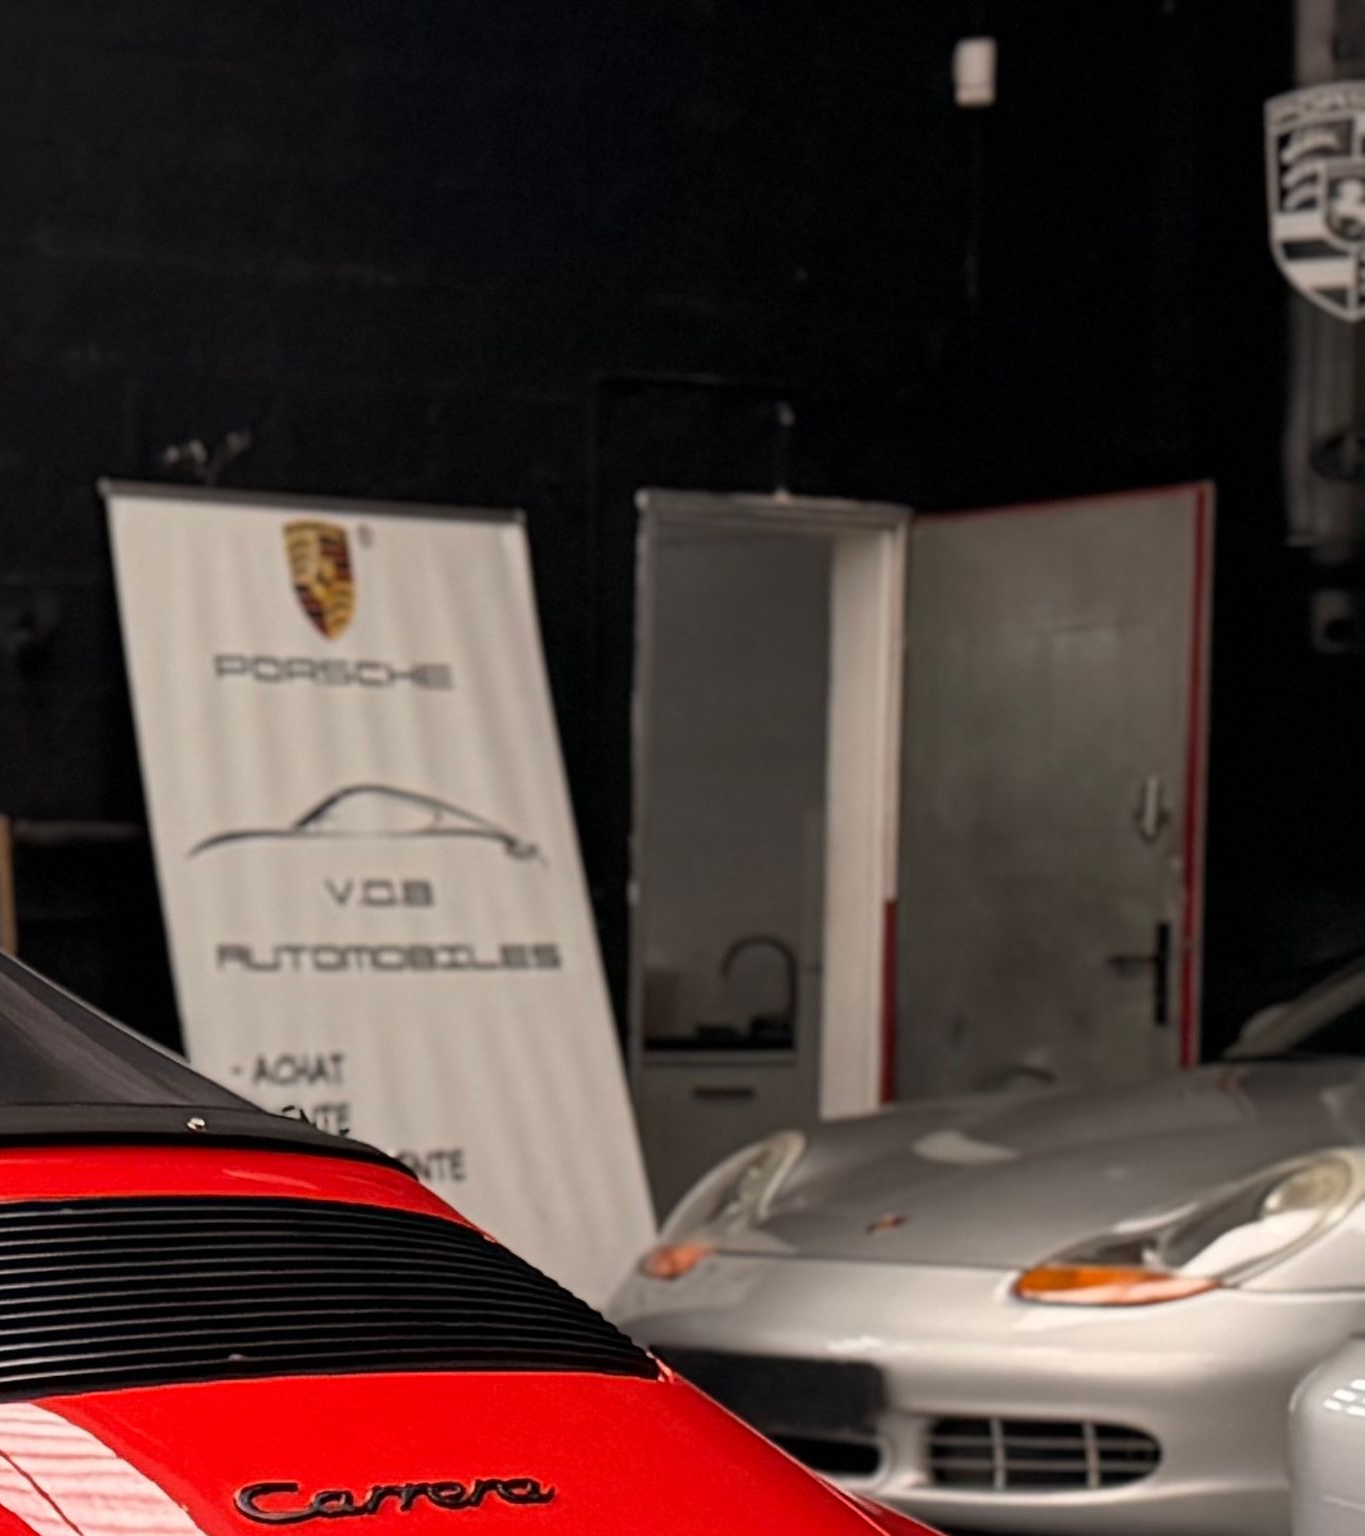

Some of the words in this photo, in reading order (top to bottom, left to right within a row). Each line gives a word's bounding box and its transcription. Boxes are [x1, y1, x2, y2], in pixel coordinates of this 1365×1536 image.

[214, 654, 453, 690] PORSCHE
[217, 943, 562, 972] AUTOMOBILES
[252, 1053, 345, 1087] ACHAT
[234, 1477, 557, 1525] Carrera
